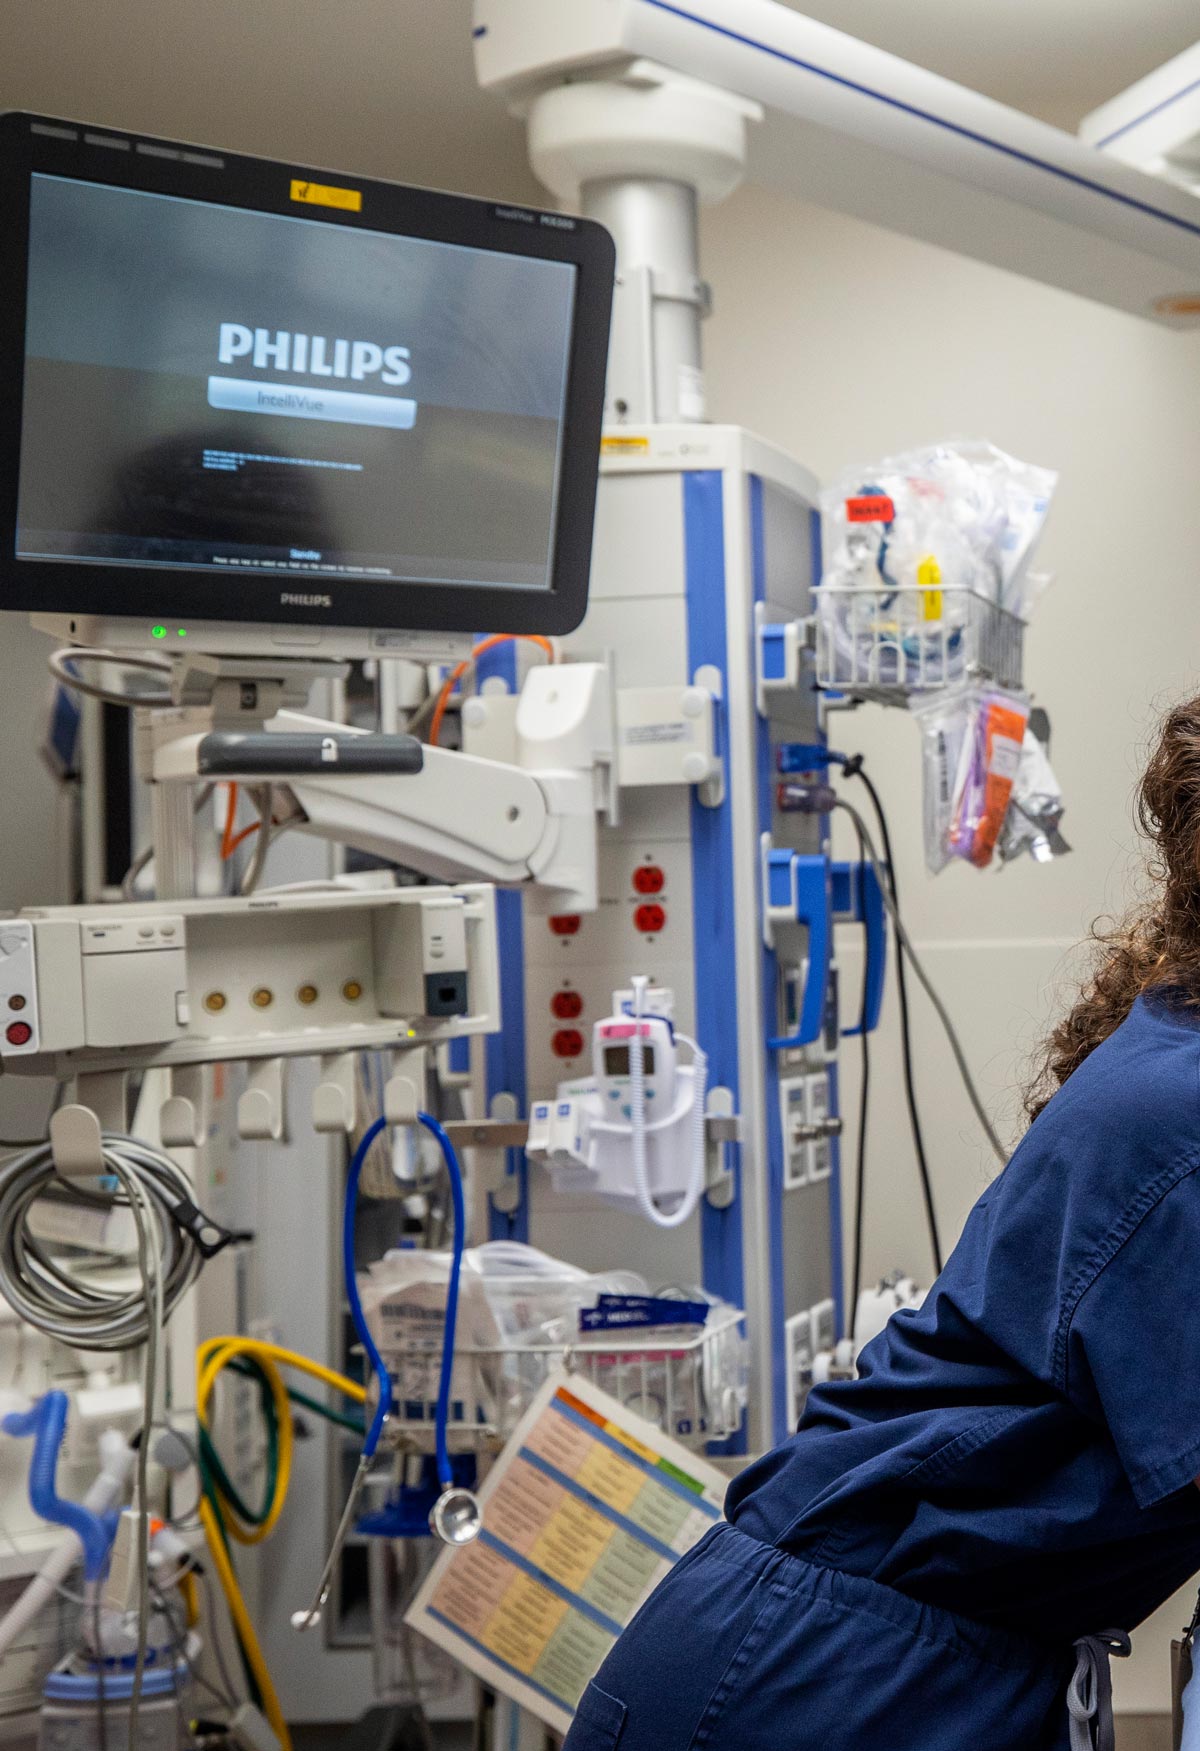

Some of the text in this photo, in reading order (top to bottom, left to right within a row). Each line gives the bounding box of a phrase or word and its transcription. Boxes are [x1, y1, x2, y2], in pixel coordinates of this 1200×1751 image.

[218, 322, 412, 386] PHILIPS
[257, 391, 324, 413] IntelliVue
[280, 592, 332, 608] PHILIPS
